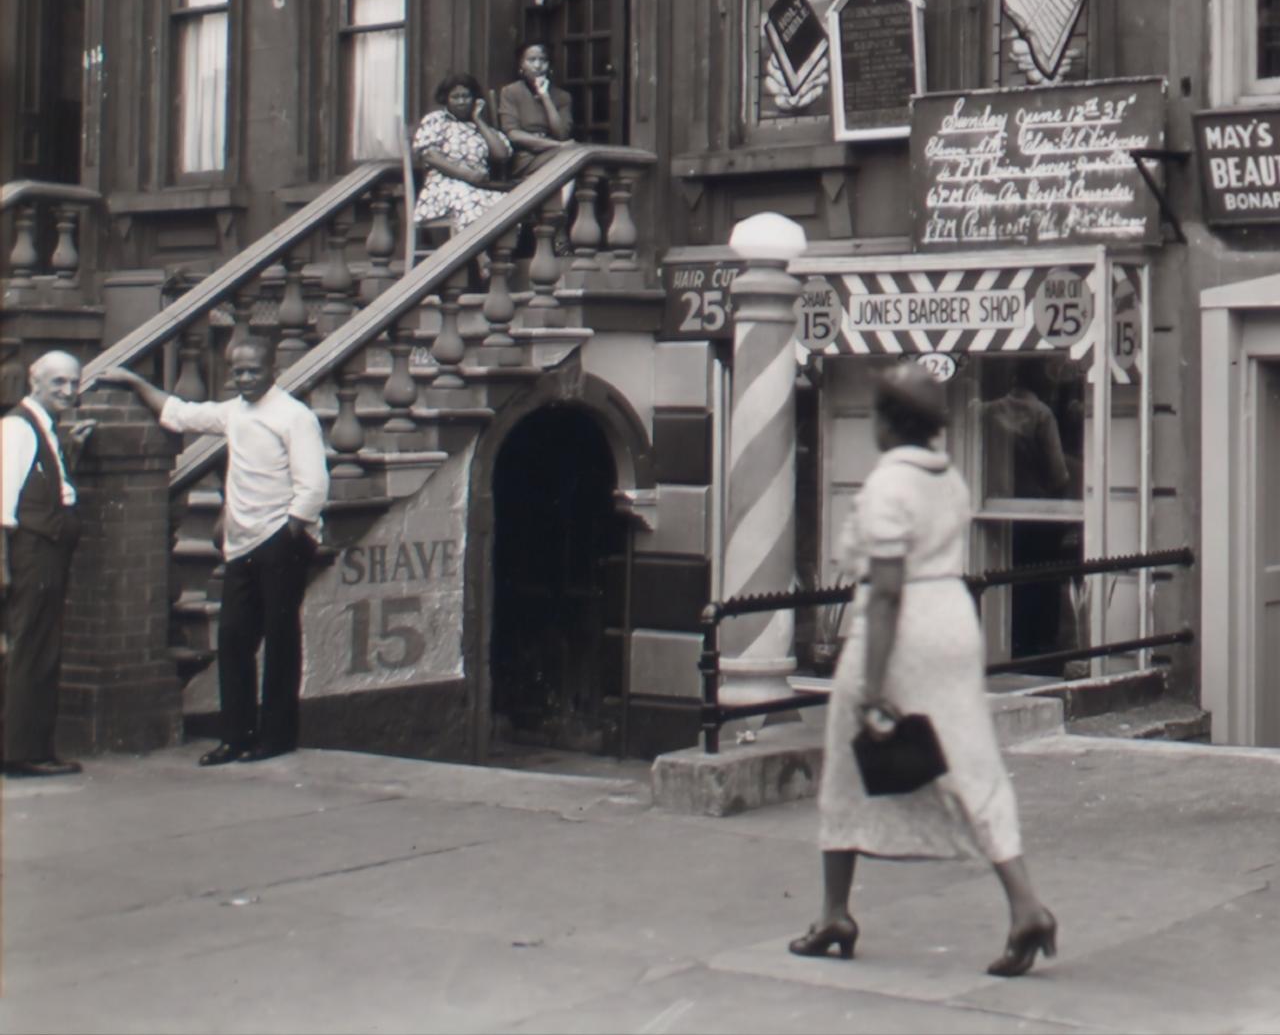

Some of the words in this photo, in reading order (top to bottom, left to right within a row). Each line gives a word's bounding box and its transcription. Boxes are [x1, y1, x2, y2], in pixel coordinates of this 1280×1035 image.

[1205, 119, 1273, 150] MAY'S
[673, 269, 705, 288] HAIR
[1044, 278, 1067, 298] HAIR
[801, 290, 833, 308] SHAVE
[854, 298, 902, 325] JONES
[908, 297, 970, 325] BARBER
[979, 295, 1021, 323] SHOP
[342, 540, 457, 586] SHAVE
